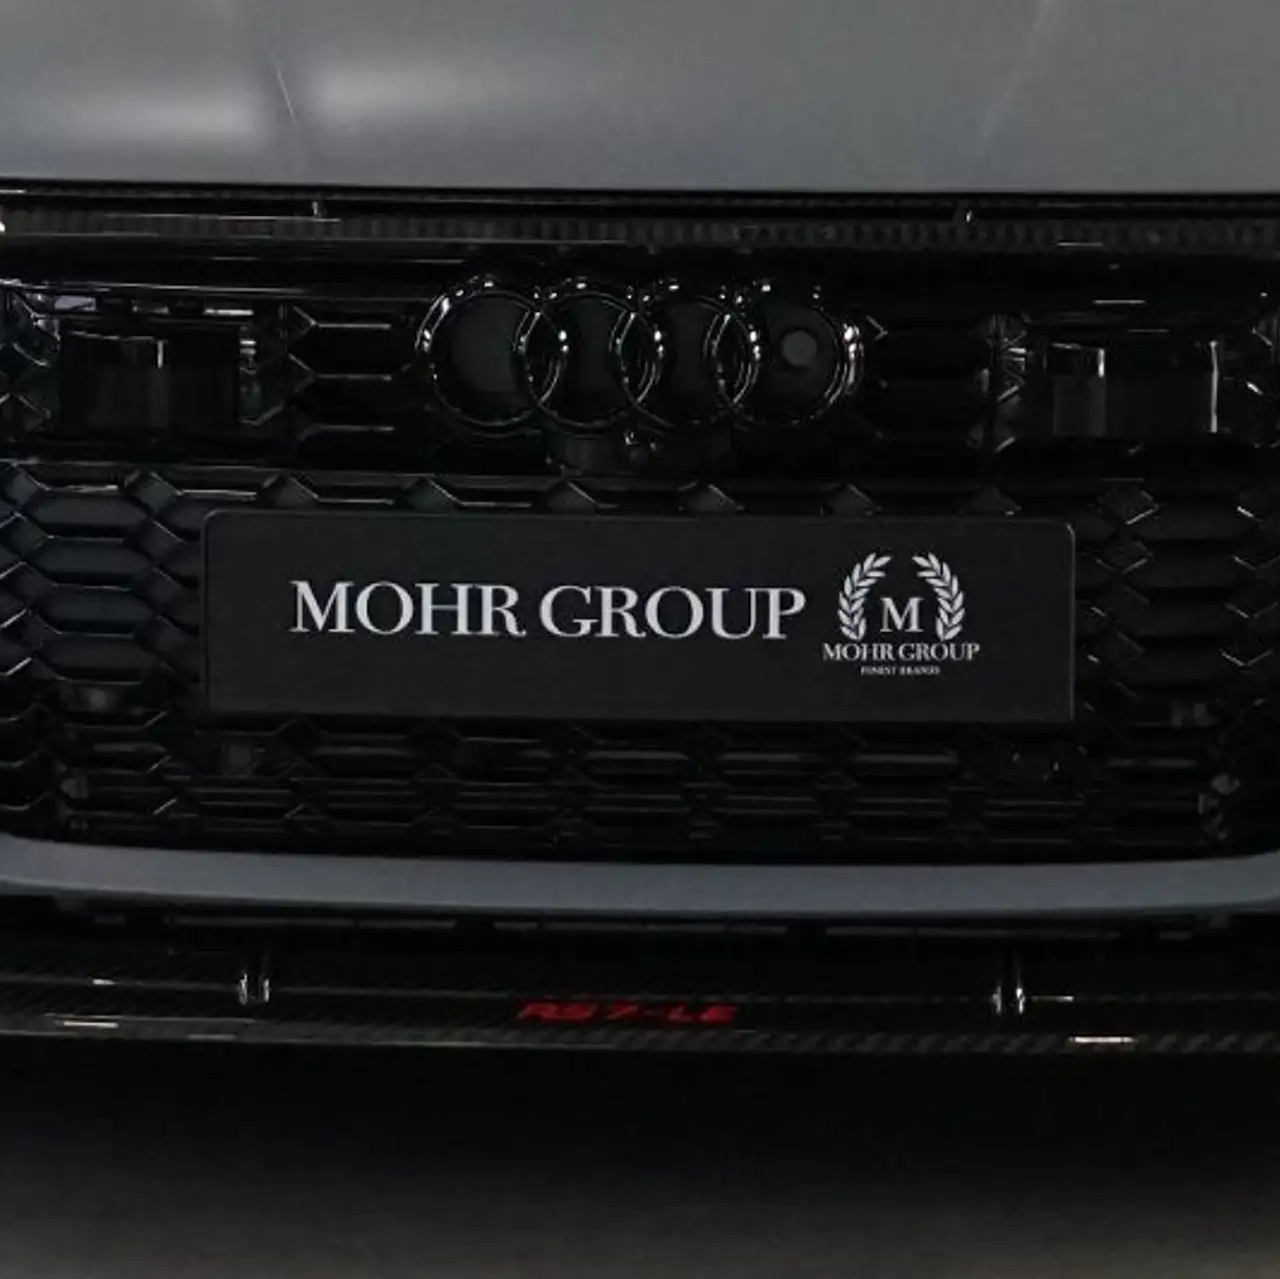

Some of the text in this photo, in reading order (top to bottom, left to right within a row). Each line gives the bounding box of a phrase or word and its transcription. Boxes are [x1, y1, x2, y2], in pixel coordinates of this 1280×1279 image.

[290, 580, 806, 640] MOHR GROUP
[879, 596, 926, 633] M
[822, 642, 981, 662] MOHR GROUP
